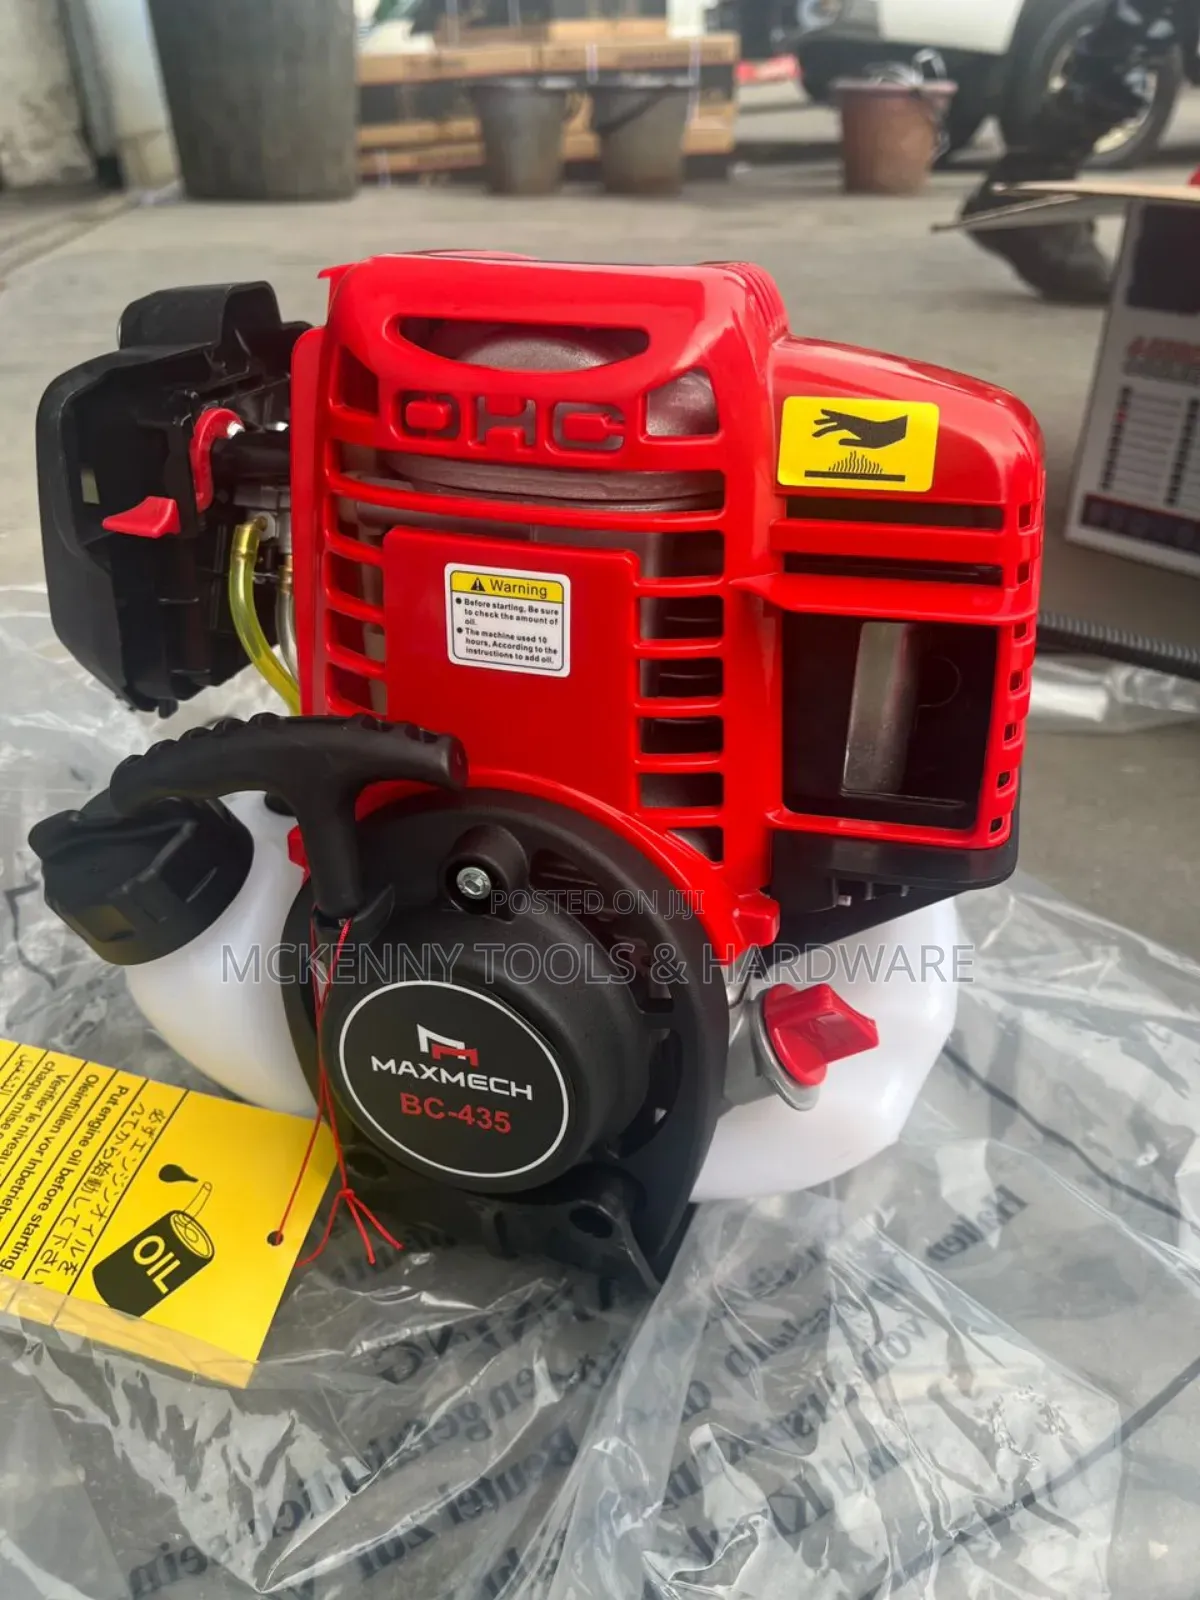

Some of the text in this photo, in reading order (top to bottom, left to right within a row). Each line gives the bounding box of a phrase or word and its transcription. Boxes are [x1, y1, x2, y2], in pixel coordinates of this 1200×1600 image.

[399, 390, 626, 451] OHC
[490, 578, 548, 600] Warning
[464, 598, 491, 609] Before
[528, 605, 540, 614] Be
[541, 607, 559, 616] sure
[464, 608, 558, 626] to check the amount of
[465, 627, 548, 644] The machine used 10
[465, 647, 514, 659] instructions
[515, 652, 523, 660] to
[525, 654, 540, 662] add
[492, 641, 534, 653] According
[535, 645, 543, 653] to
[544, 646, 558, 655] the
[370, 1055, 533, 1101] MAXMECH
[1, 1060, 56, 1131] chaque mise
[25, 1112, 41, 1124] le
[400, 1091, 512, 1134] BC-435
[35, 1135, 55, 1157] vor
[0, 1085, 130, 1273] Put engine oil before starting.
[133, 1235, 181, 1294] OIL
